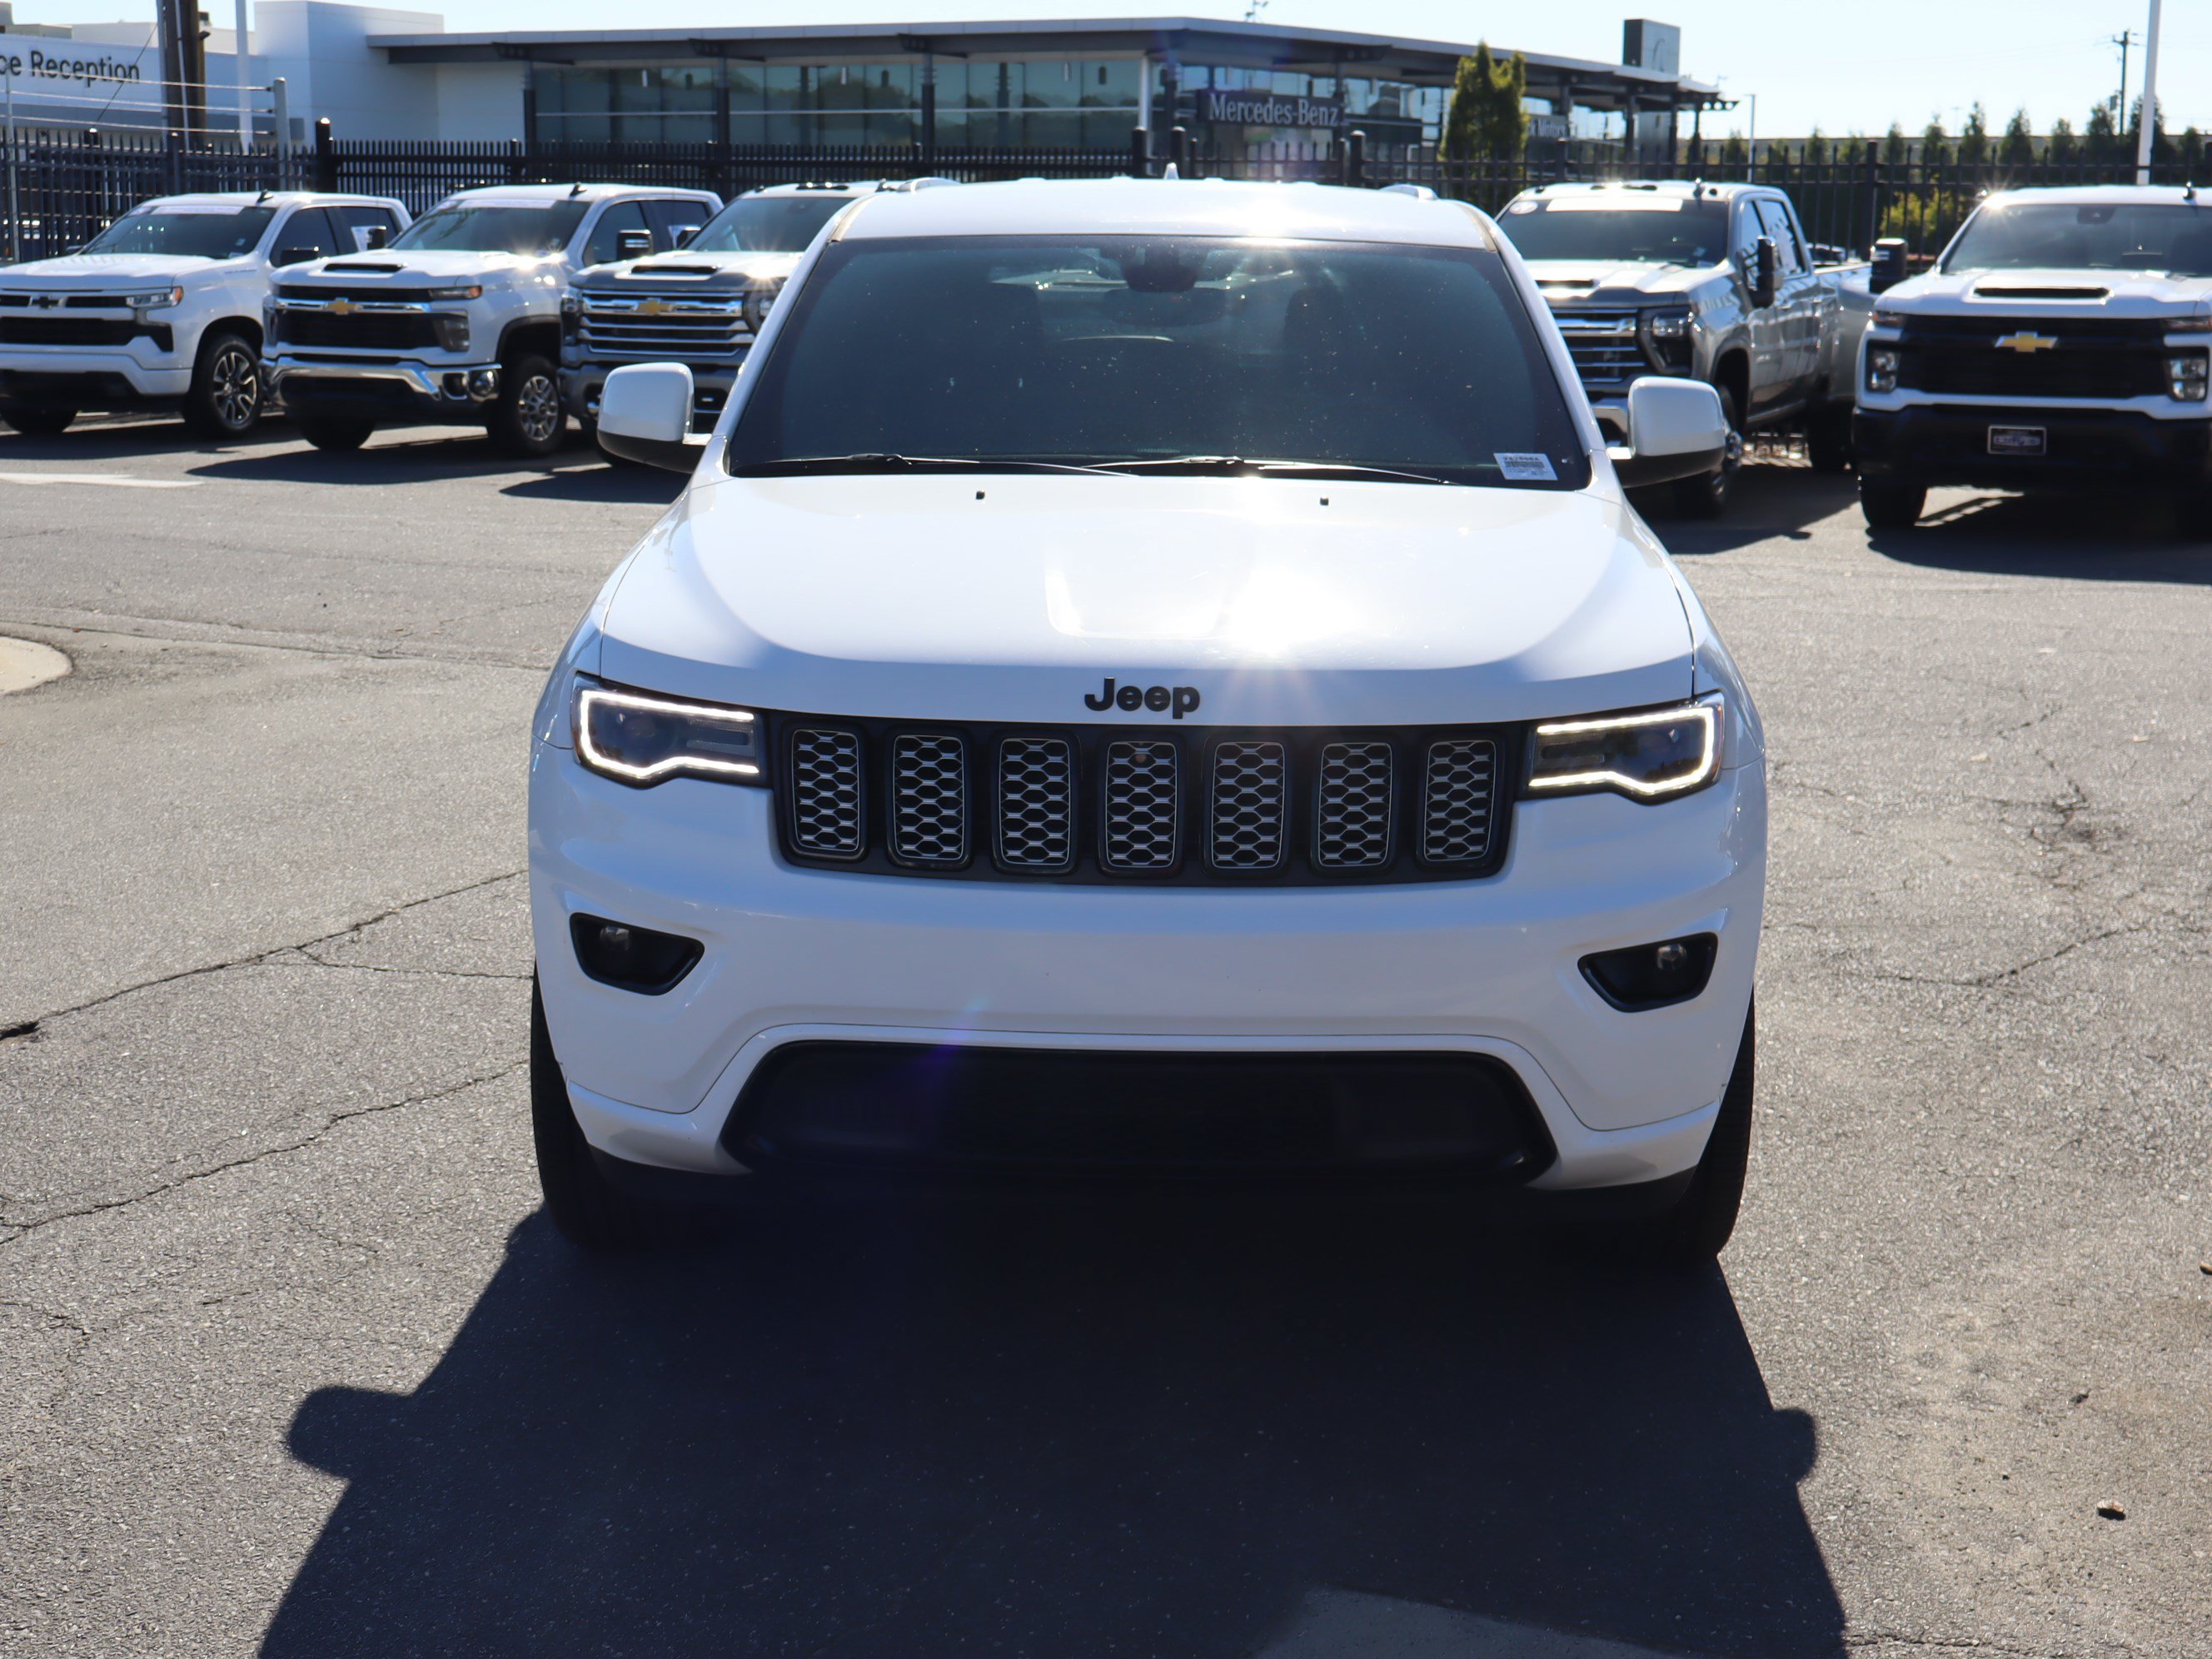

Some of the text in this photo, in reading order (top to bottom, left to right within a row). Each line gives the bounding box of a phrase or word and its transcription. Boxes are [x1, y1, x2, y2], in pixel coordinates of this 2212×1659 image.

[30, 49, 140, 87] Reception
[1208, 92, 1339, 127] Mercedes-Benz
[1084, 676, 1200, 720] Jeep
